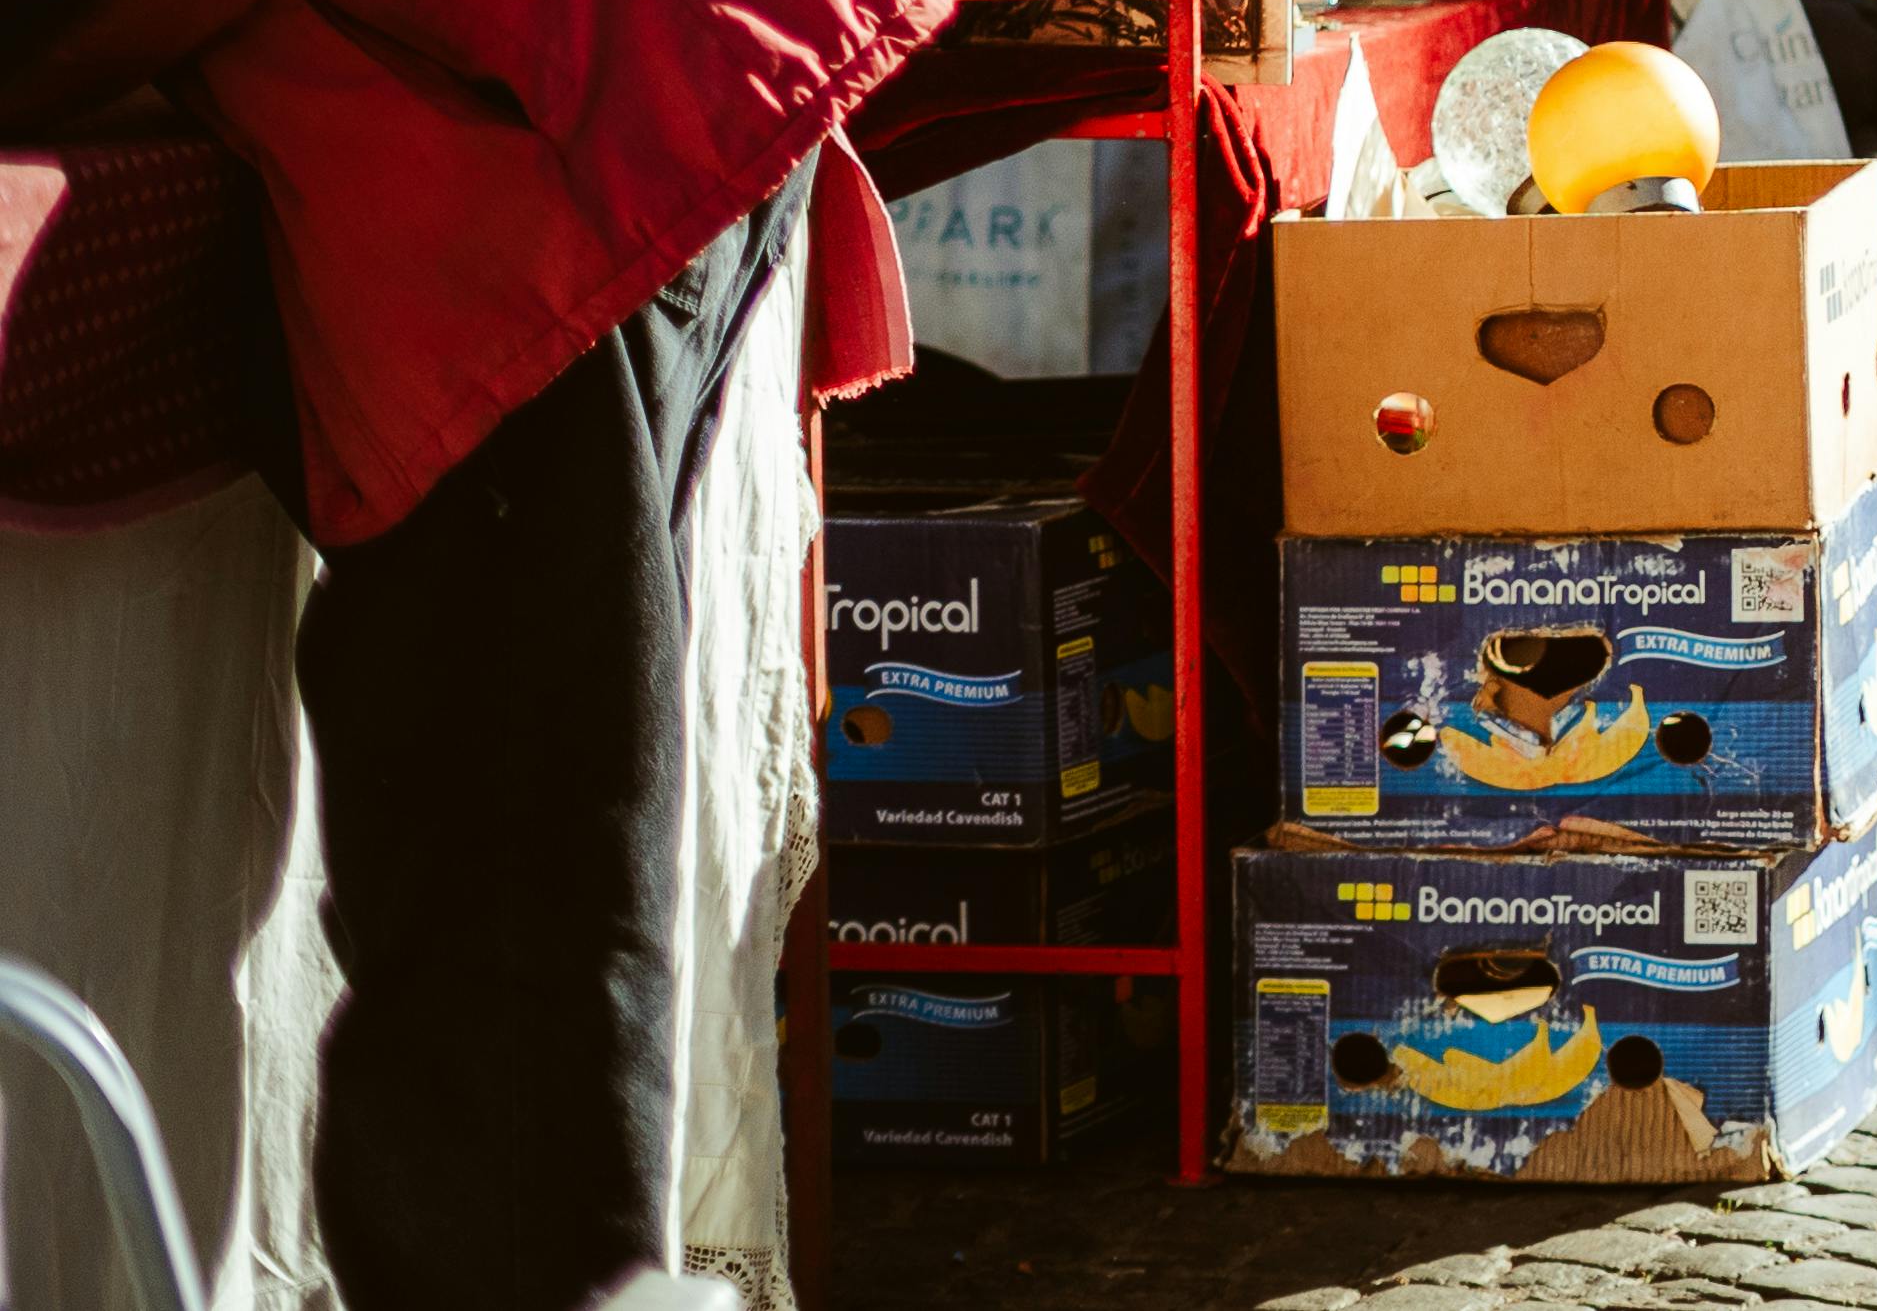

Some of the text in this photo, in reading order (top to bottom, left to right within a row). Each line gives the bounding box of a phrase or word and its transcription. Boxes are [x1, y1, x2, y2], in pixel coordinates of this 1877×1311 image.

[1463, 569, 1706, 616] BananaTropical
[1635, 634, 1772, 662] EXTRA PREMIUM
[880, 671, 1010, 700] EXTRA PREMIUM
[981, 792, 1022, 807] CAT 1
[876, 810, 1024, 826] Variedad Cavendish
[1418, 885, 1661, 937] BananaTropical
[1588, 954, 1726, 985] EXTRA PREMIUM
[868, 992, 999, 1021] EXTRA PREMIUM
[971, 1113, 1001, 1127] CAT
[864, 1130, 1013, 1147] Variedad Cavendish
